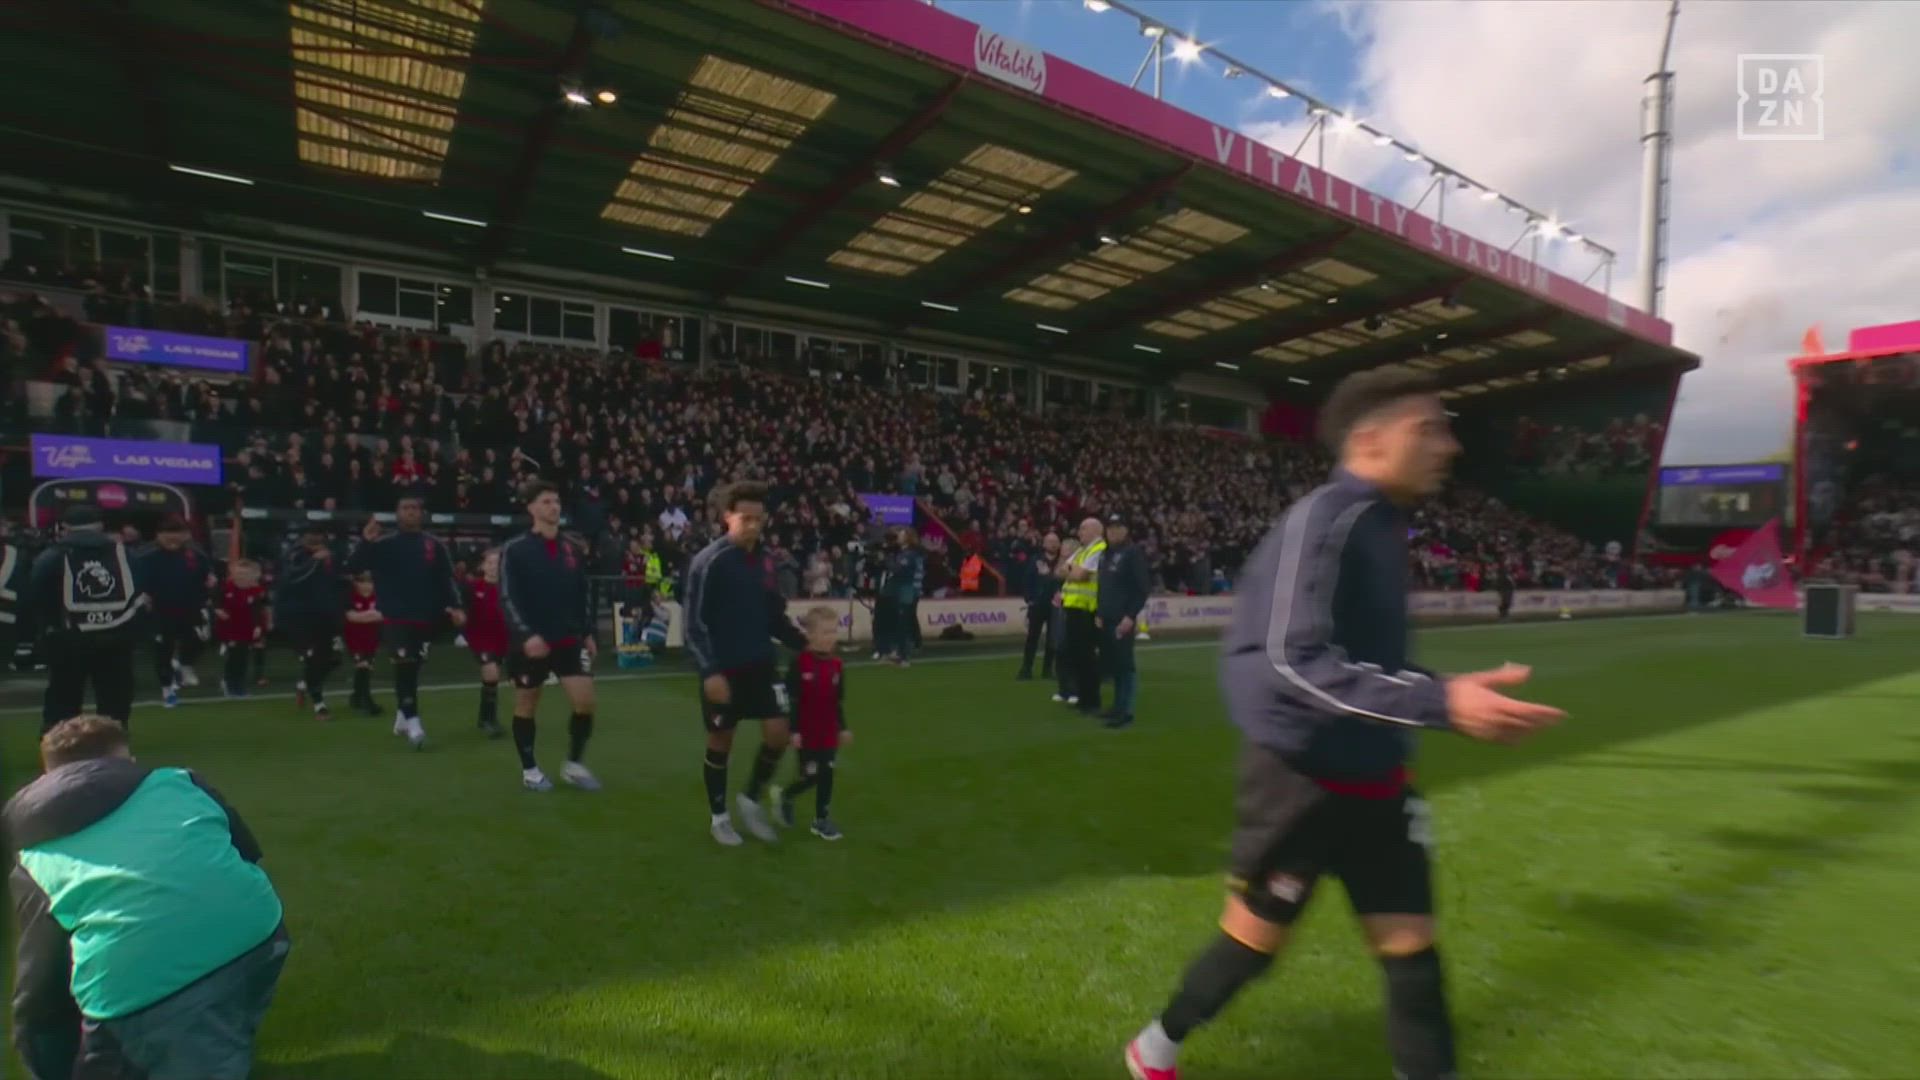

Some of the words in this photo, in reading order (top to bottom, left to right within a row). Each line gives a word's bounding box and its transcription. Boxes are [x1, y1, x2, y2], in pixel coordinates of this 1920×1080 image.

[979, 33, 1043, 92] Vitality
[1212, 125, 1407, 236] VITALITY
[1430, 221, 1550, 295] STADIUM
[113, 454, 150, 465] LAS
[153, 456, 214, 469] VEGAS
[87, 611, 113, 624] 036
[927, 613, 957, 625] LAS
[959, 611, 1007, 625] VEGAS
